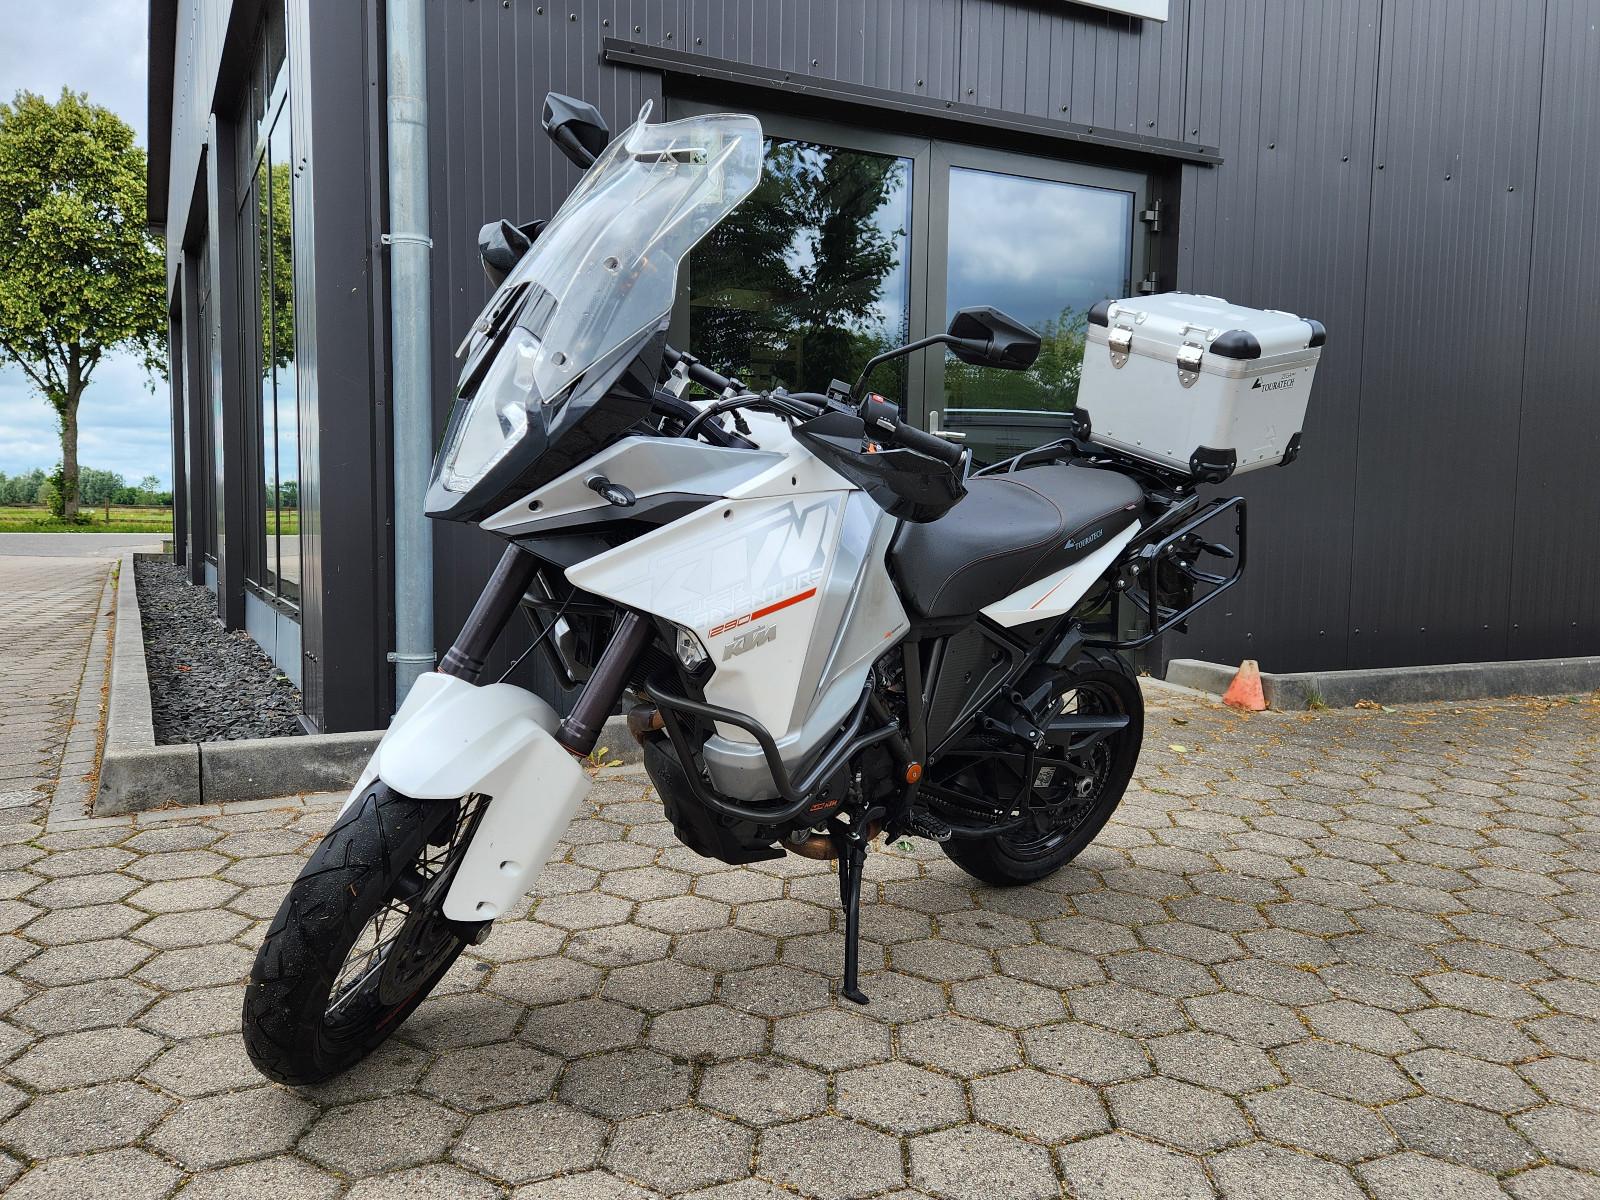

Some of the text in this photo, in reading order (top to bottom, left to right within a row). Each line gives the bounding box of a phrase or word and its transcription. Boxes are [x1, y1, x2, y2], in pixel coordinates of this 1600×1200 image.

[1261, 378, 1295, 392] TOURATECH
[1075, 529, 1103, 549] TOURATECH
[708, 613, 751, 639] 1290
[722, 623, 777, 661] KTM
